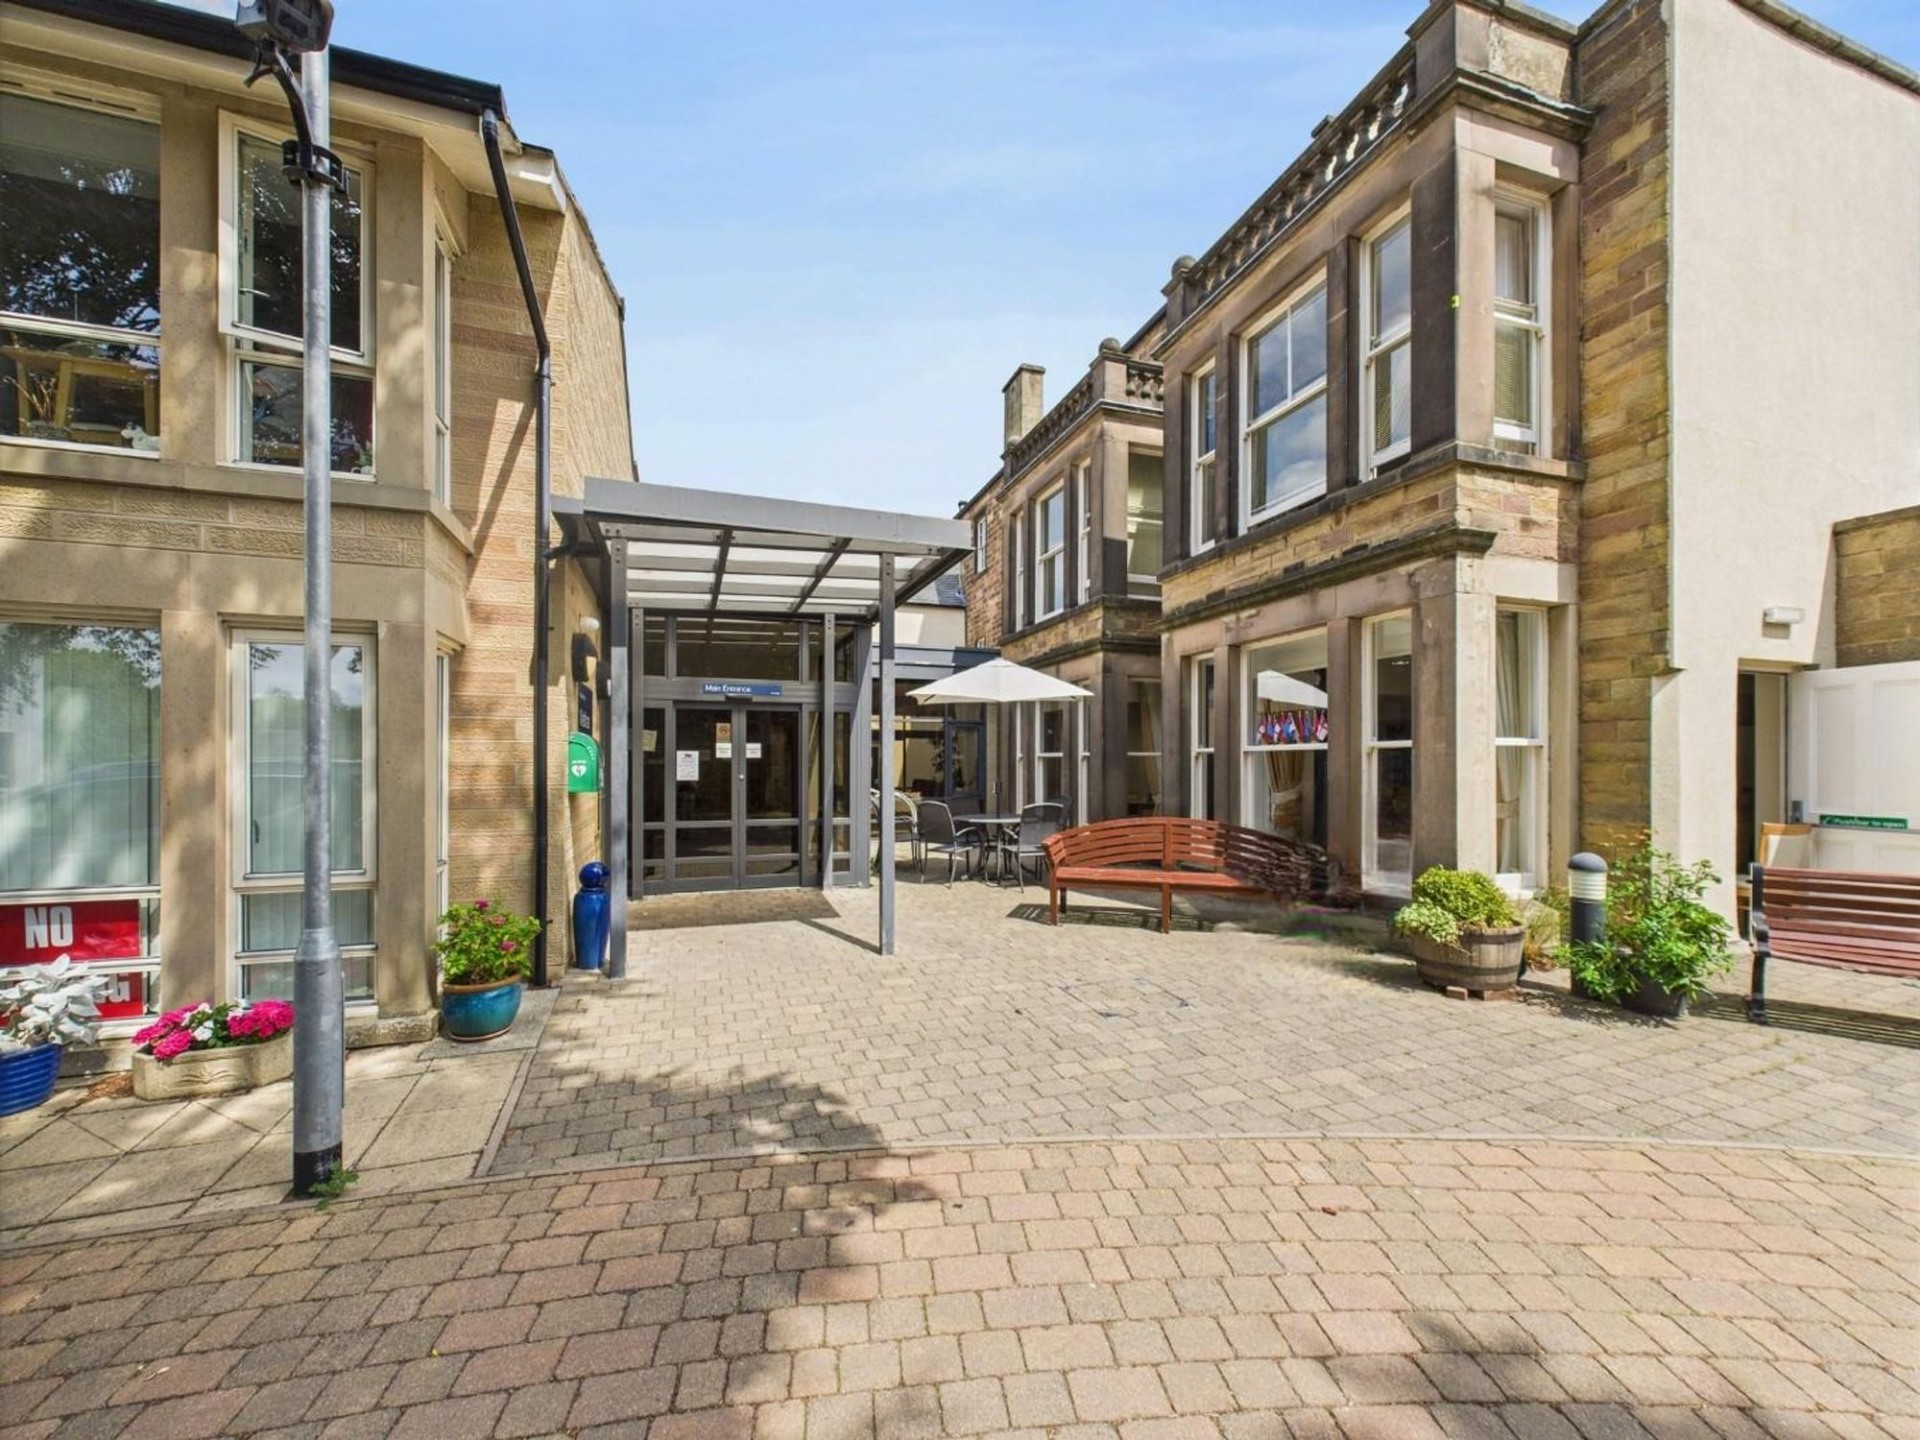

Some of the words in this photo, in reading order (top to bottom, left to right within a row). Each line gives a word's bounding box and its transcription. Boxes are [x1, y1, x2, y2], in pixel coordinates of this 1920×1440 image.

[705, 684, 721, 693] Main
[722, 684, 752, 693] Entrance
[24, 905, 73, 949] NO
